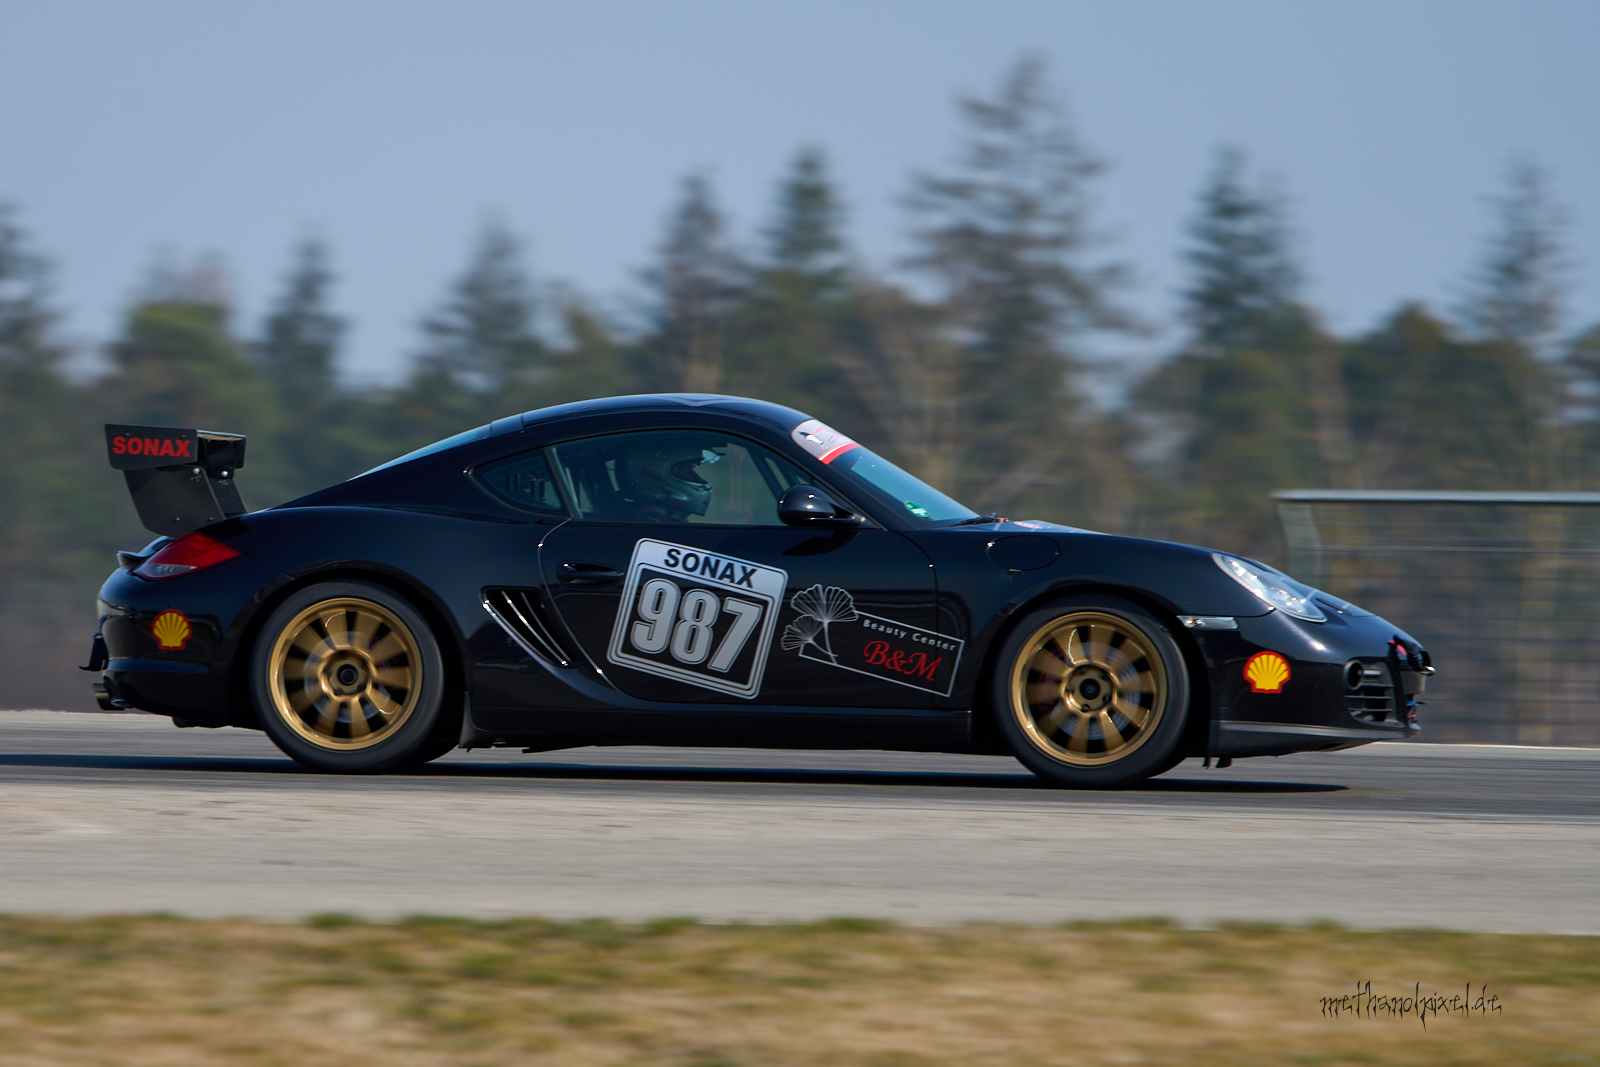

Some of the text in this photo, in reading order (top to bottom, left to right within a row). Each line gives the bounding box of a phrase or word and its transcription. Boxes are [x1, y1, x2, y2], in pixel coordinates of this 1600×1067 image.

[112, 436, 191, 457] SONAX
[664, 548, 758, 588] SONAX
[630, 578, 763, 673] 987
[863, 618, 956, 652] Beauty Center
[863, 640, 943, 682] B&M
